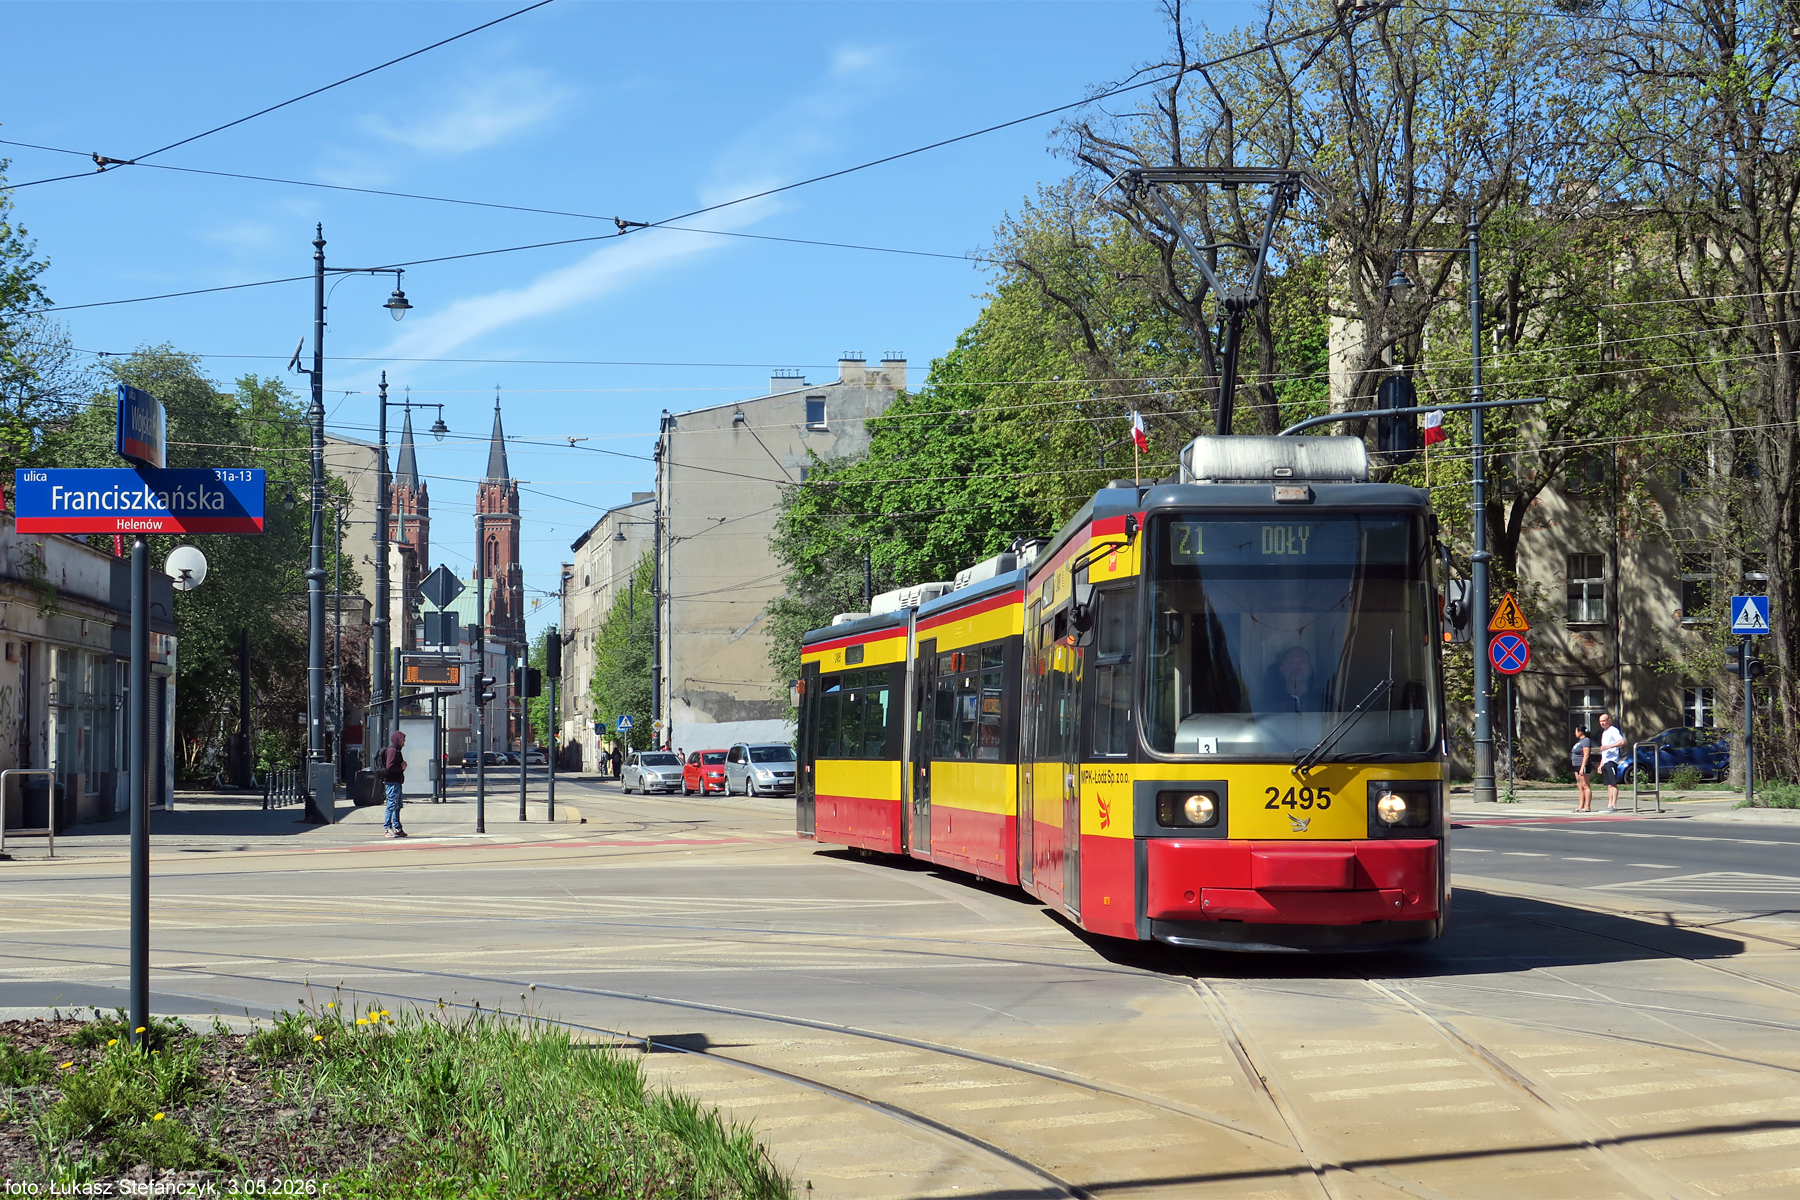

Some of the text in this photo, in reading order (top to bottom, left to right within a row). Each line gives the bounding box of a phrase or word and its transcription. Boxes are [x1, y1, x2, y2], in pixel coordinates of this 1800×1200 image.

[131, 404, 152, 441] Wojska
[23, 470, 48, 482] ulica
[215, 470, 252, 482] 31a-13
[52, 484, 225, 511] Franciszkańska
[116, 518, 163, 530] Helenów
[1262, 526, 1310, 554] DOŁY
[1203, 744, 1211, 754] 3
[1264, 786, 1332, 810] 2495
